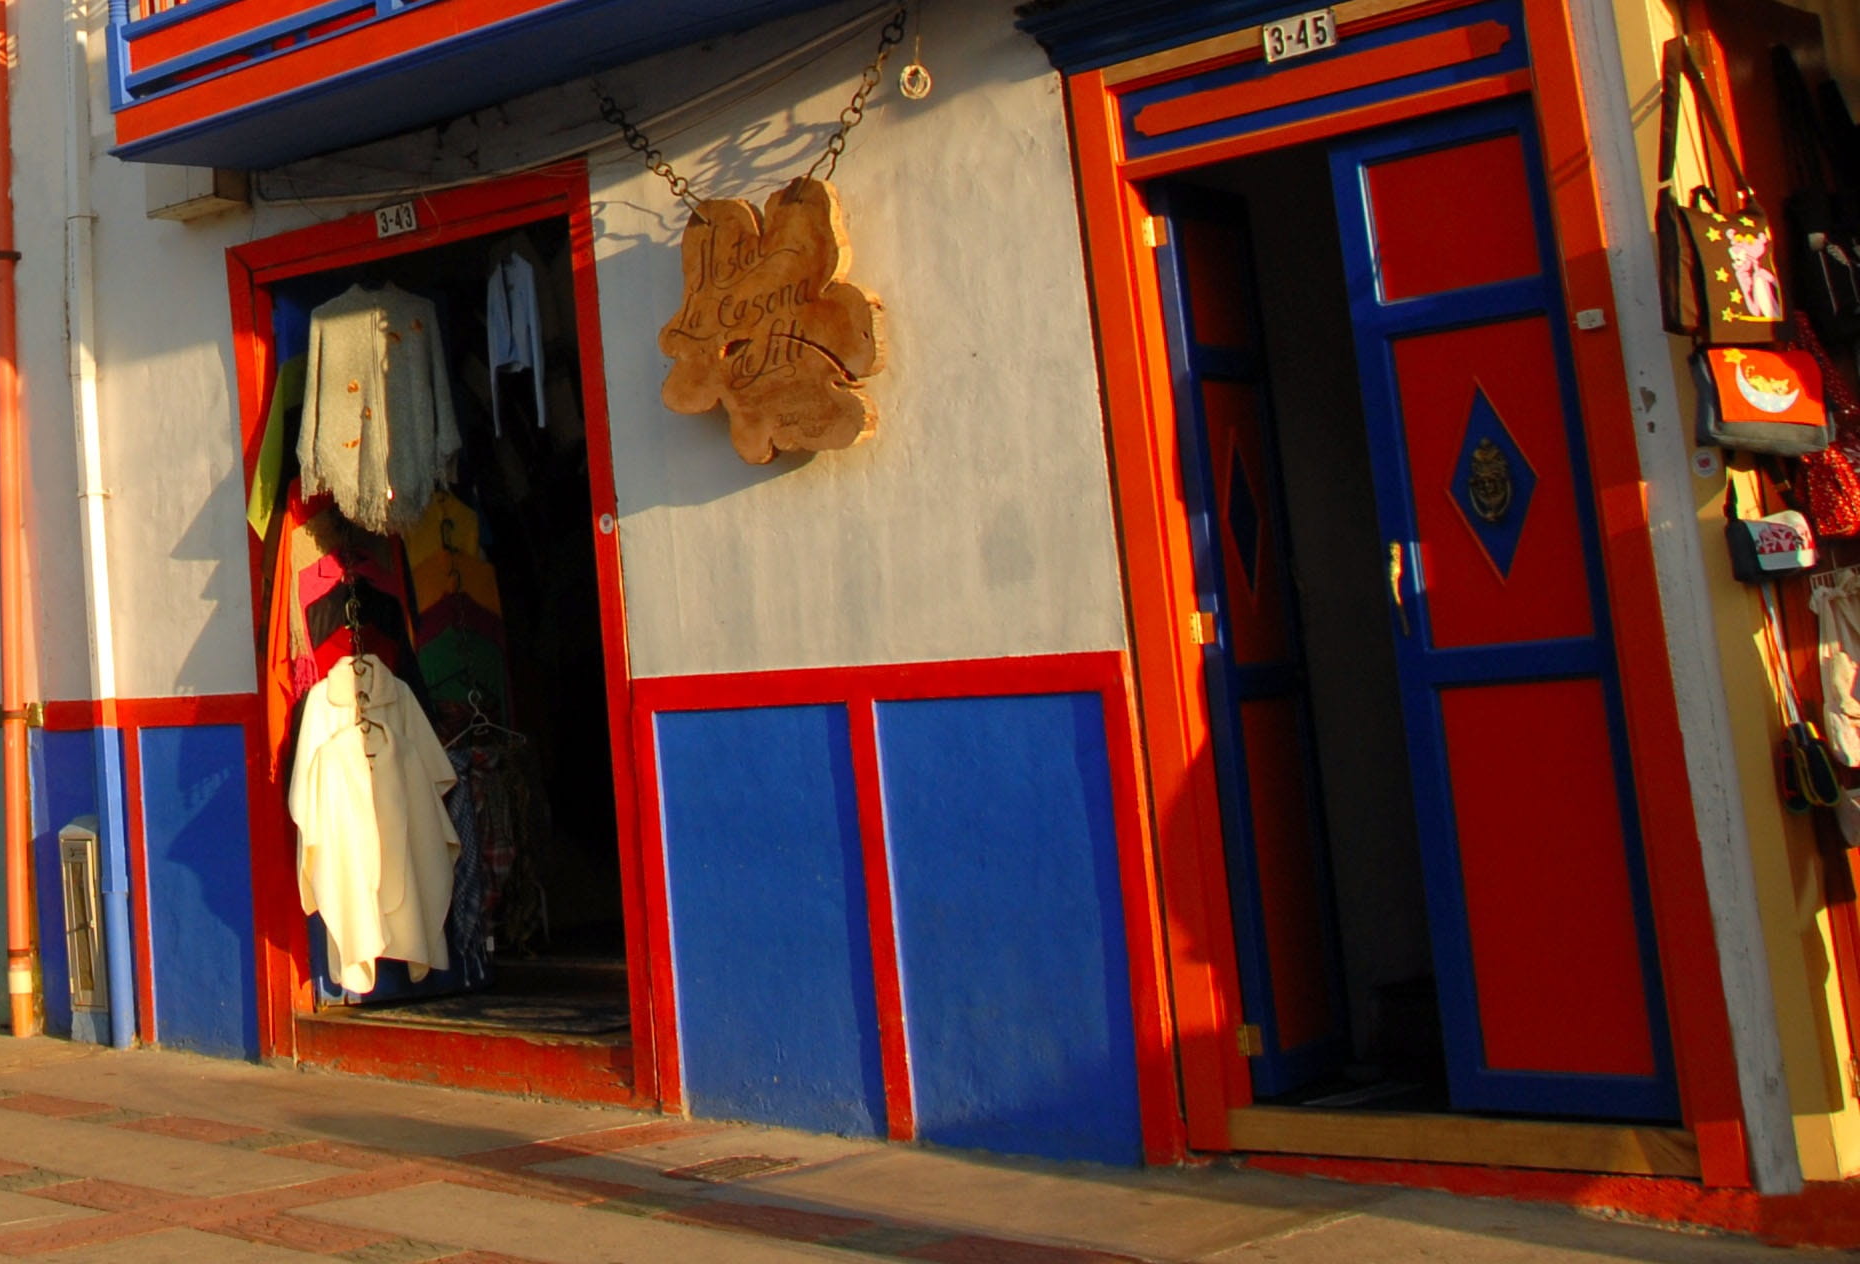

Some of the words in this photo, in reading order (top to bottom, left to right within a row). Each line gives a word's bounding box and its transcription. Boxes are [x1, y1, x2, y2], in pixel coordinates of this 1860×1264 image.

[1271, 15, 1327, 56] 3-45
[379, 205, 413, 234] 3-43
[669, 292, 719, 342] La
[717, 278, 813, 330] Casona
